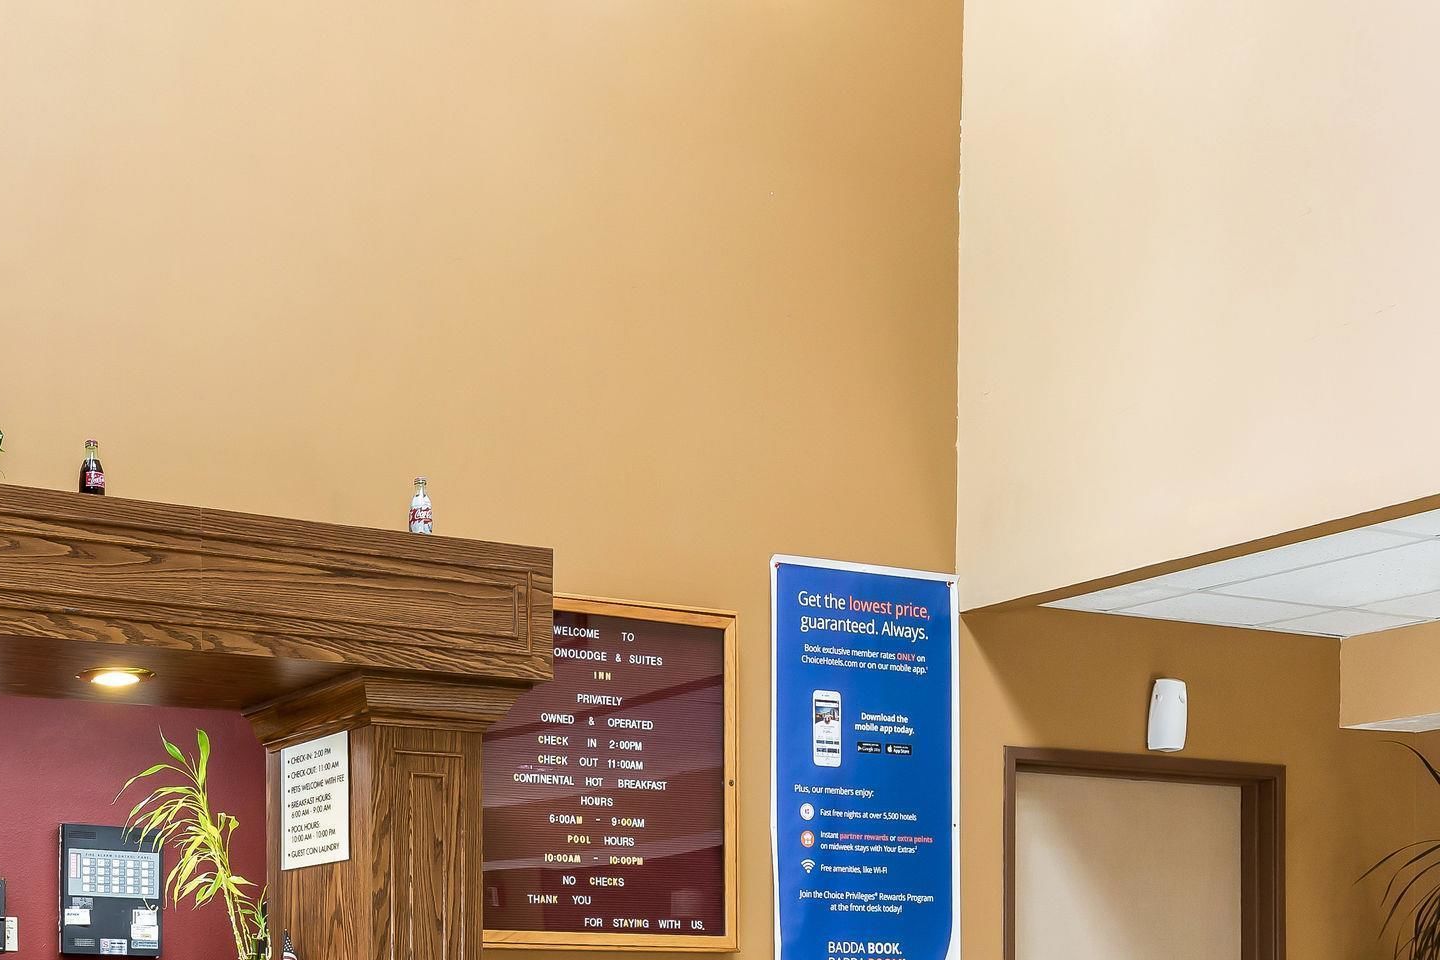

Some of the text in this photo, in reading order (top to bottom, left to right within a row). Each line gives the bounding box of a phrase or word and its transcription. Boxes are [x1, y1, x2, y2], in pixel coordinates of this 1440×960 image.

[798, 591, 930, 620] Get the lowest price,
[554, 626, 635, 642] WELCOME TO
[801, 615, 928, 642] guaranteed. Always.
[554, 648, 663, 666] ONOLODGE & SUITES
[805, 644, 821, 652] Book
[822, 646, 850, 655] exclusive
[852, 649, 879, 657] member
[880, 652, 895, 660] rates
[897, 653, 915, 661] ONLY
[802, 655, 858, 667] ChoiceHotels.com
[890, 664, 911, 672] mobile
[594, 672, 611, 680] INN
[577, 694, 622, 706] PRIVATELY
[541, 713, 653, 730] OWNED & OPERATED
[861, 712, 908, 723] Download the
[855, 723, 914, 736] mobile app today.
[538, 735, 642, 751] CHECK IN 2:00PM
[314, 750, 323, 758] 2:00
[319, 763, 331, 773] 11:00
[538, 755, 643, 770] CHECK OUT 11:00AM
[291, 785, 300, 794] PETS
[302, 780, 324, 792] WELCOME
[325, 776, 336, 786] WITH
[514, 773, 667, 791] CONTINENTAL HOT BREAKFAST
[794, 784, 810, 793] Plus,
[825, 787, 854, 796] members
[855, 790, 874, 799] enjoy:
[291, 796, 314, 808] BREAKFAST
[581, 797, 613, 807] HOURS
[549, 815, 644, 828] 6:00AM 9:00AM
[844, 810, 861, 819] nights
[883, 812, 899, 820] 5,500
[900, 813, 917, 821] hotels
[291, 823, 303, 833] POOL
[568, 835, 634, 846] POOL HOURS
[821, 831, 838, 839] Instant
[914, 836, 933, 844] points
[291, 843, 339, 858] GUEST COIN LAUNDRY
[829, 843, 854, 851] midweek
[855, 845, 869, 853] stays
[870, 844, 883, 852] with
[544, 854, 643, 865] 10:00AM 10:00PM
[833, 866, 861, 874] amenities,
[873, 866, 887, 874] Wi-Fi
[563, 876, 624, 887] NO CHECKS
[527, 895, 591, 905] THANK YOU
[799, 890, 812, 899] Join
[824, 891, 844, 900] Choice
[880, 893, 906, 901] Rewards
[907, 894, 933, 903] Program
[838, 903, 849, 911] the
[850, 904, 865, 912] front
[867, 904, 881, 912] desk
[883, 905, 902, 914] today!
[585, 918, 705, 930] FOR STAYING WITH US.
[828, 942, 902, 954] BADDA BOOK.
